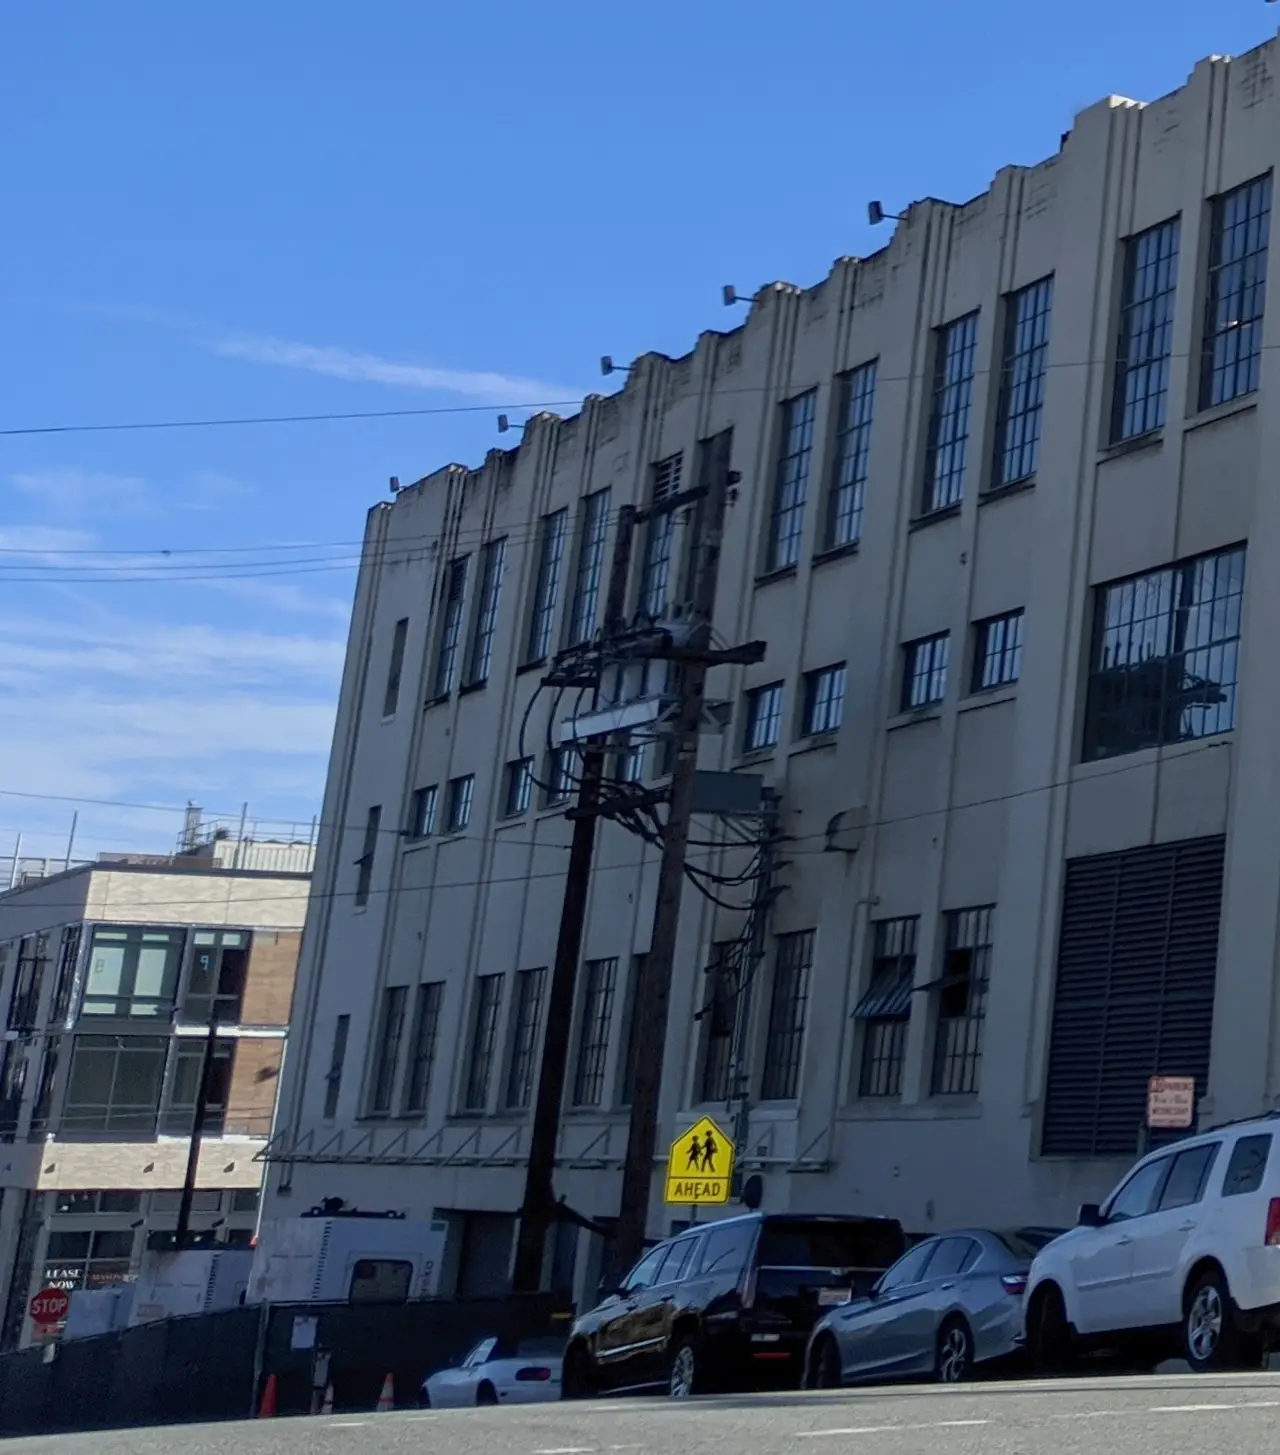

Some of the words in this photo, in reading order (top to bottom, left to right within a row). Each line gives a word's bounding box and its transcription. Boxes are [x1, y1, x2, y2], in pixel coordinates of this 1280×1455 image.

[674, 1182, 721, 1198] AHEAD
[45, 1268, 82, 1279] LEASE
[48, 1280, 76, 1289] NOW
[31, 1296, 68, 1316] STOP
